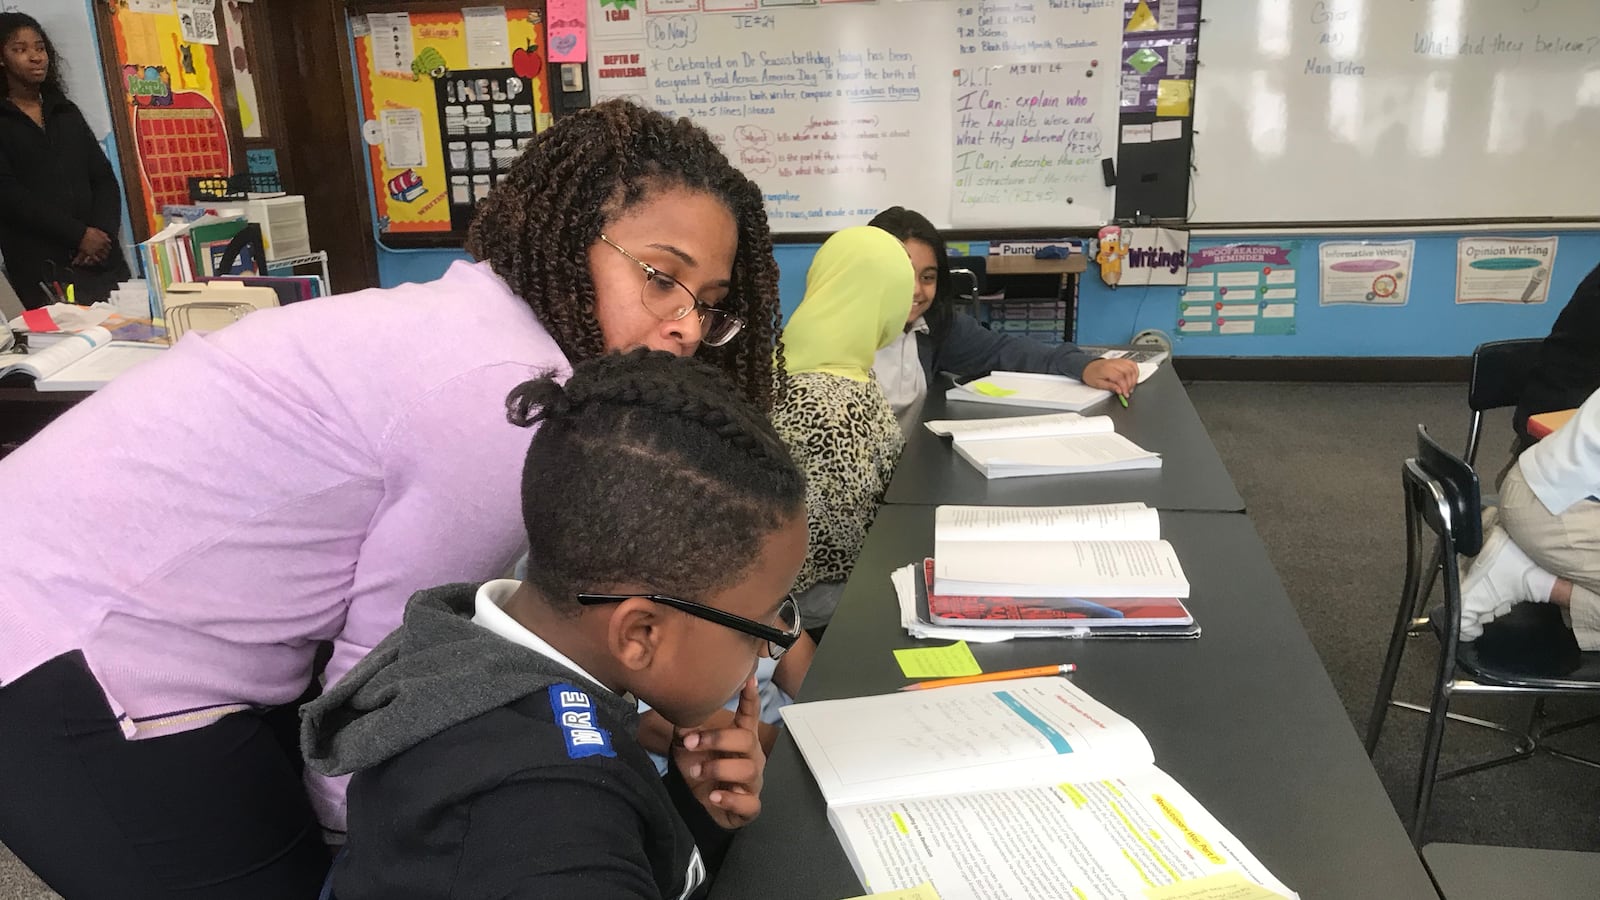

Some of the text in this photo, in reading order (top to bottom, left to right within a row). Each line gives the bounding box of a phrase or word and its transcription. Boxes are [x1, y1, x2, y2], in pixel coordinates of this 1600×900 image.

[612, 10, 630, 21] CAN
[654, 24, 665, 41] Do
[1413, 32, 1449, 55] What
[1459, 34, 1485, 55] did
[1490, 32, 1524, 62] they
[603, 54, 640, 65] DEPTH OF
[667, 56, 722, 72] Celebrated
[726, 59, 738, 68] on
[867, 48, 883, 61] has
[889, 48, 912, 61] been
[1304, 57, 1366, 75] Main Idea
[598, 68, 647, 79] KNOWLEDGE
[655, 74, 700, 92] designated
[762, 68, 795, 82] America
[956, 90, 978, 112] I
[1016, 90, 1058, 110] explain
[1066, 90, 1088, 106] who
[960, 112, 980, 128] the
[1074, 112, 1095, 124] and
[956, 130, 984, 146] what
[990, 131, 1015, 149] they
[1022, 129, 1066, 143] believed
[1010, 154, 1053, 168] describe
[1003, 244, 1044, 255] Punctu
[1202, 246, 1277, 257] PROOFREADING
[1325, 248, 1407, 258] Informative Writing
[1466, 245, 1549, 258] Opinion Writing
[1128, 247, 1186, 274] Writing!
[1214, 254, 1265, 263] REMINDER
